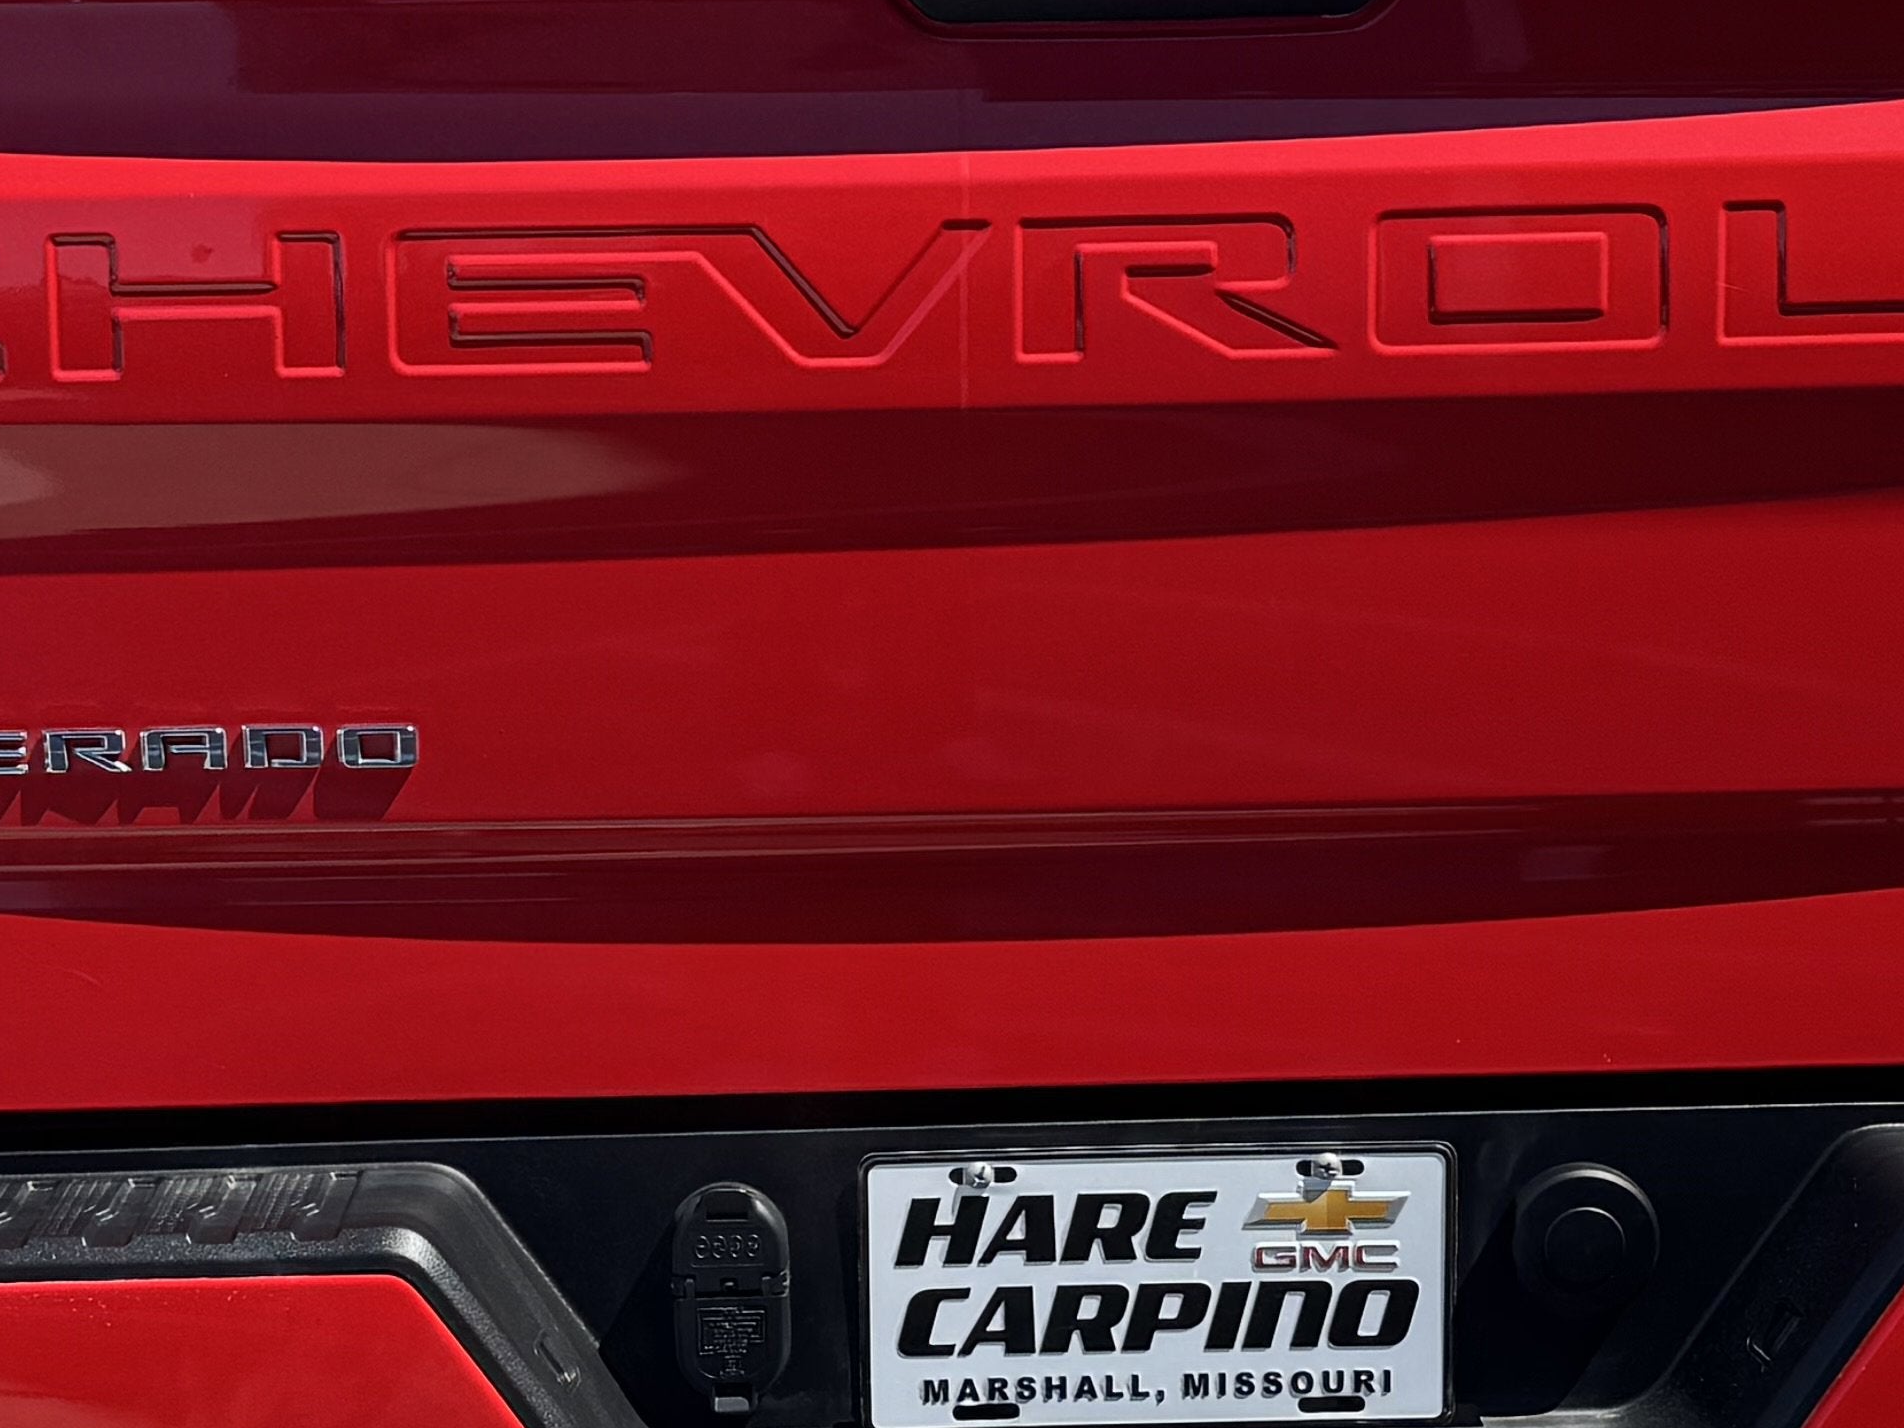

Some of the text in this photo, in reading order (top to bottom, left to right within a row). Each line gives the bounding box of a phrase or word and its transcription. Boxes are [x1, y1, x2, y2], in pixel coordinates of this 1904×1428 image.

[894, 1189, 1218, 1269] HARE
[1250, 1239, 1402, 1273] GMC
[895, 1278, 1421, 1358] CARPINO
[920, 1368, 1394, 1405] MARSHALL, MISSOURI
